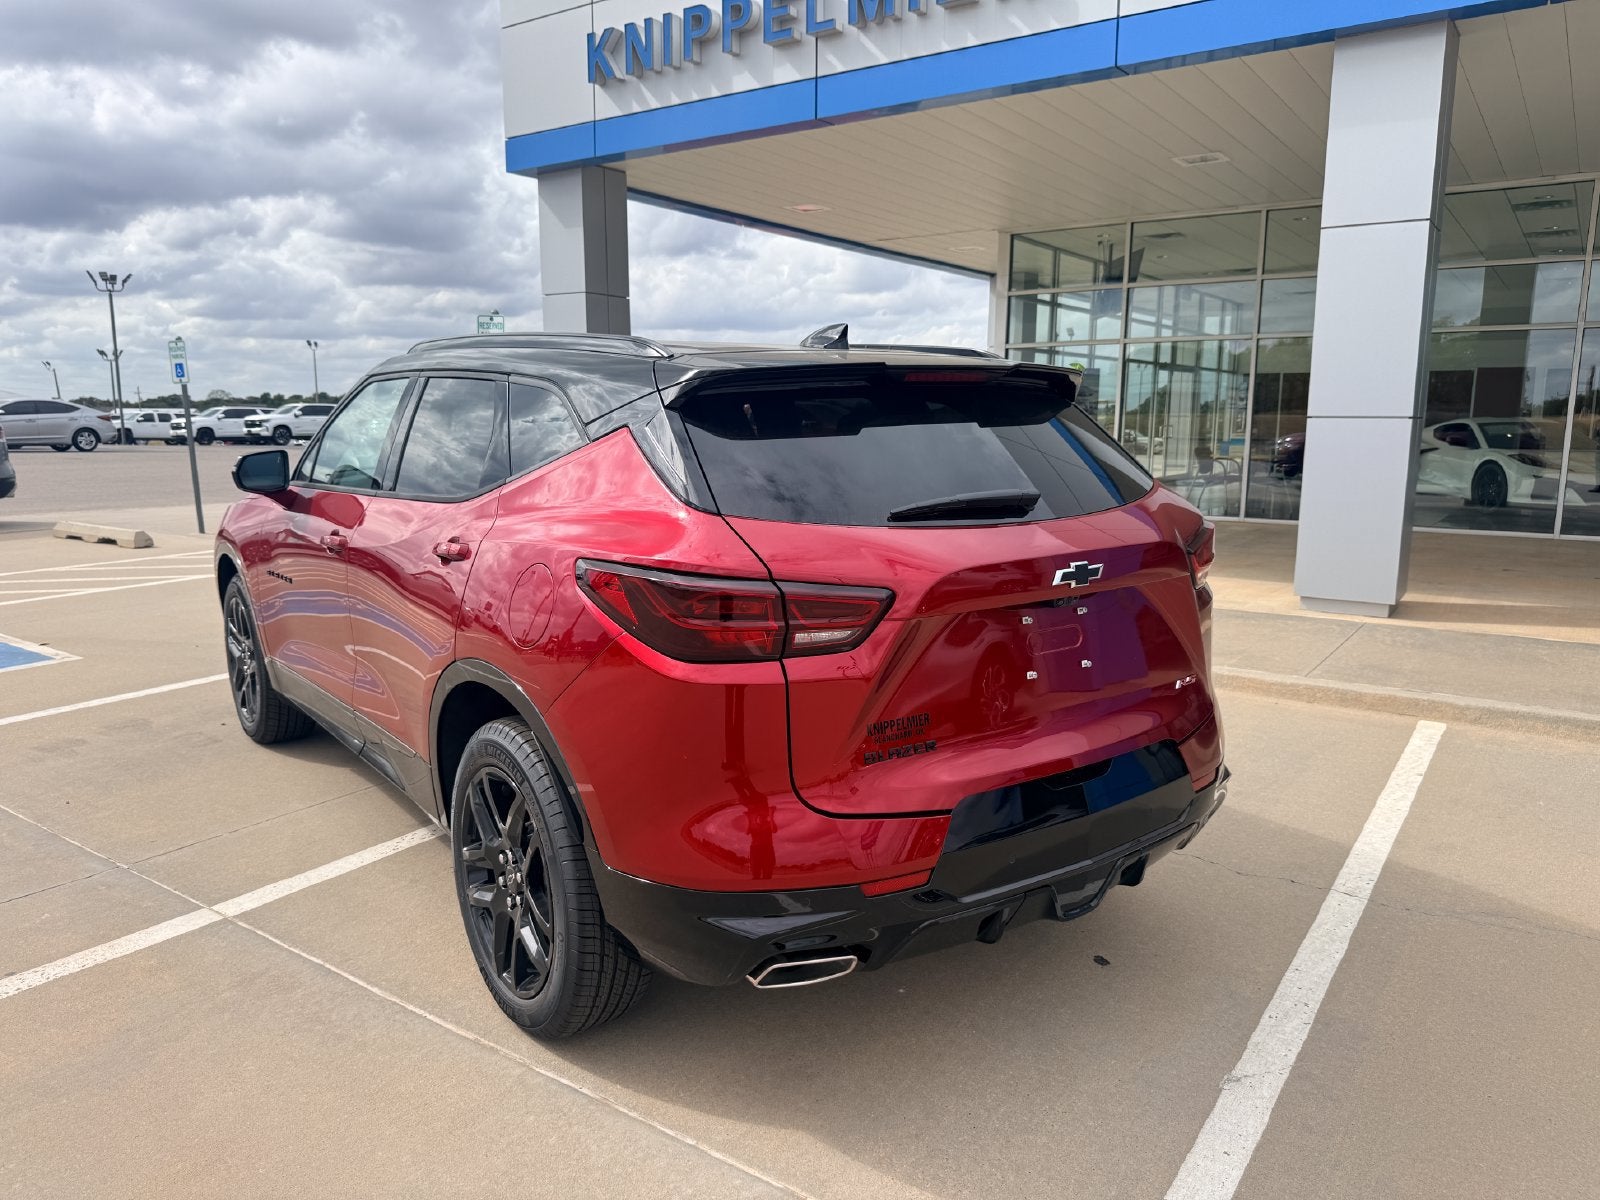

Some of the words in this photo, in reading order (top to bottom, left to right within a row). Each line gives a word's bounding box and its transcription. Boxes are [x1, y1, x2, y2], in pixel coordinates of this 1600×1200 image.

[587, 0, 1000, 84] KNIPPEL
[866, 712, 930, 737] KNIPPELMIER
[864, 740, 937, 765] BLAZER
